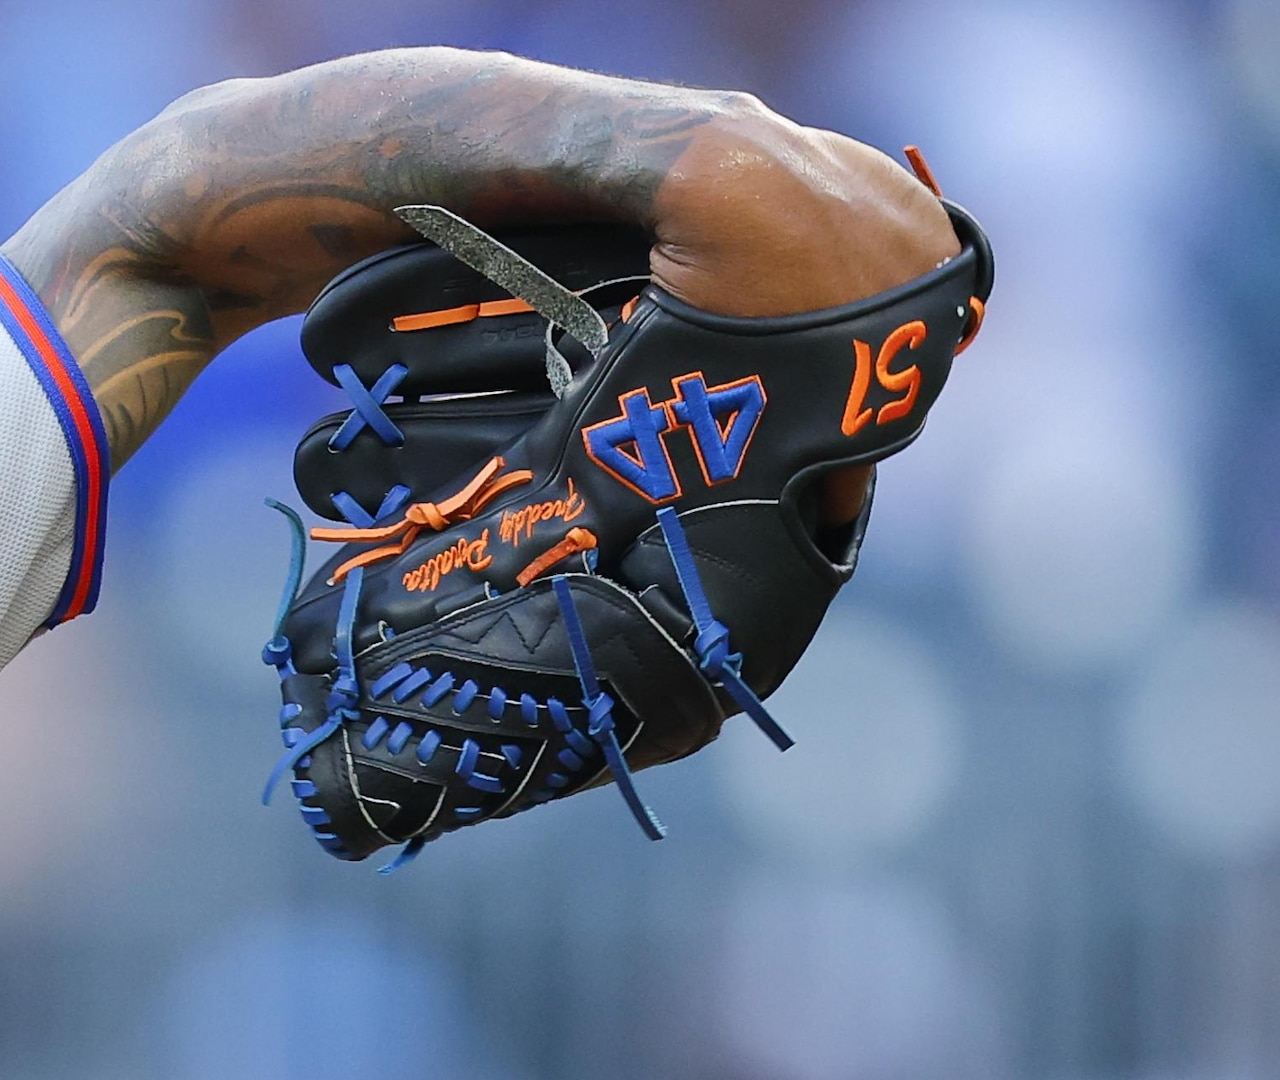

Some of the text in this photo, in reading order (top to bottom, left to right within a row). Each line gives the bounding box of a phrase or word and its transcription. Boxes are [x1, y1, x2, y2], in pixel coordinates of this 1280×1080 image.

[841, 320, 928, 437] 51
[581, 371, 768, 505] 44
[499, 476, 586, 548] Freddy
